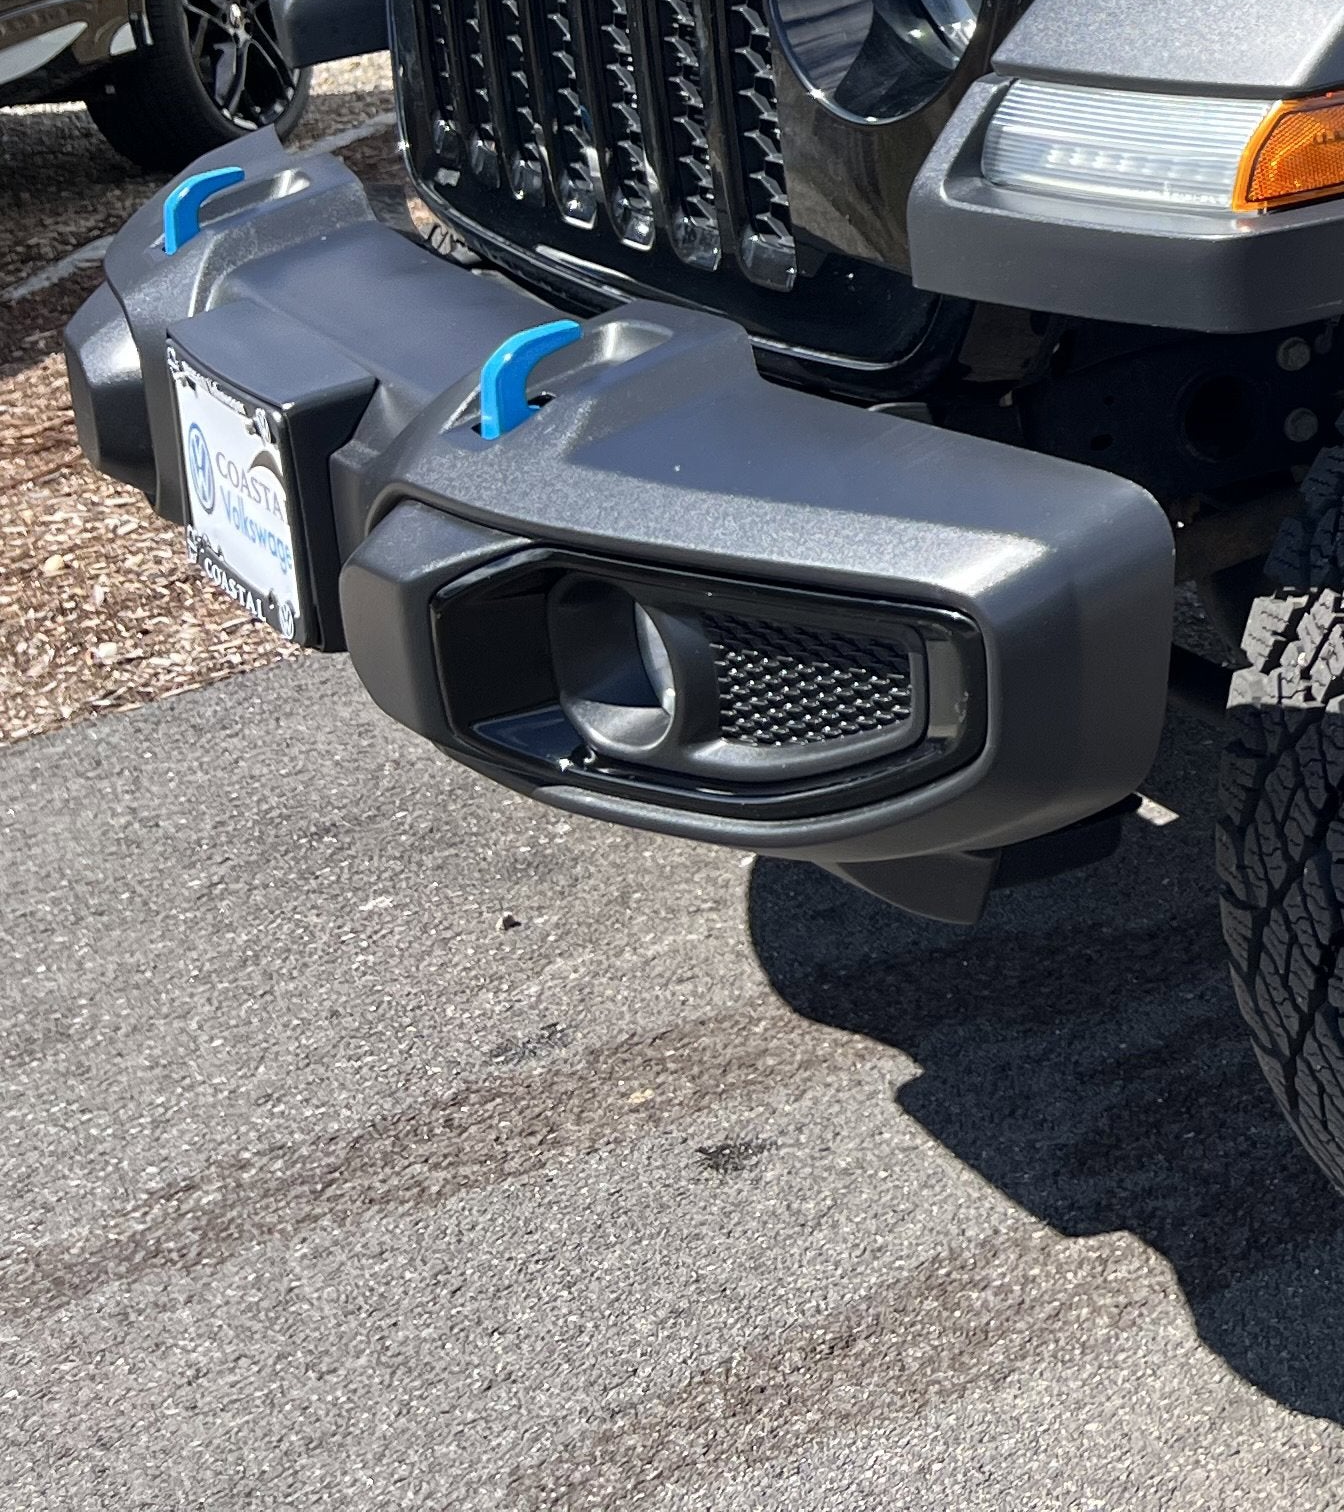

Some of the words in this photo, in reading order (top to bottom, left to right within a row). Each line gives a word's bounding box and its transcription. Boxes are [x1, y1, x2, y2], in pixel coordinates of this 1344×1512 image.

[215, 451, 285, 522] COASTA
[220, 485, 293, 575] Volkswage
[204, 557, 267, 623] COASTAL
